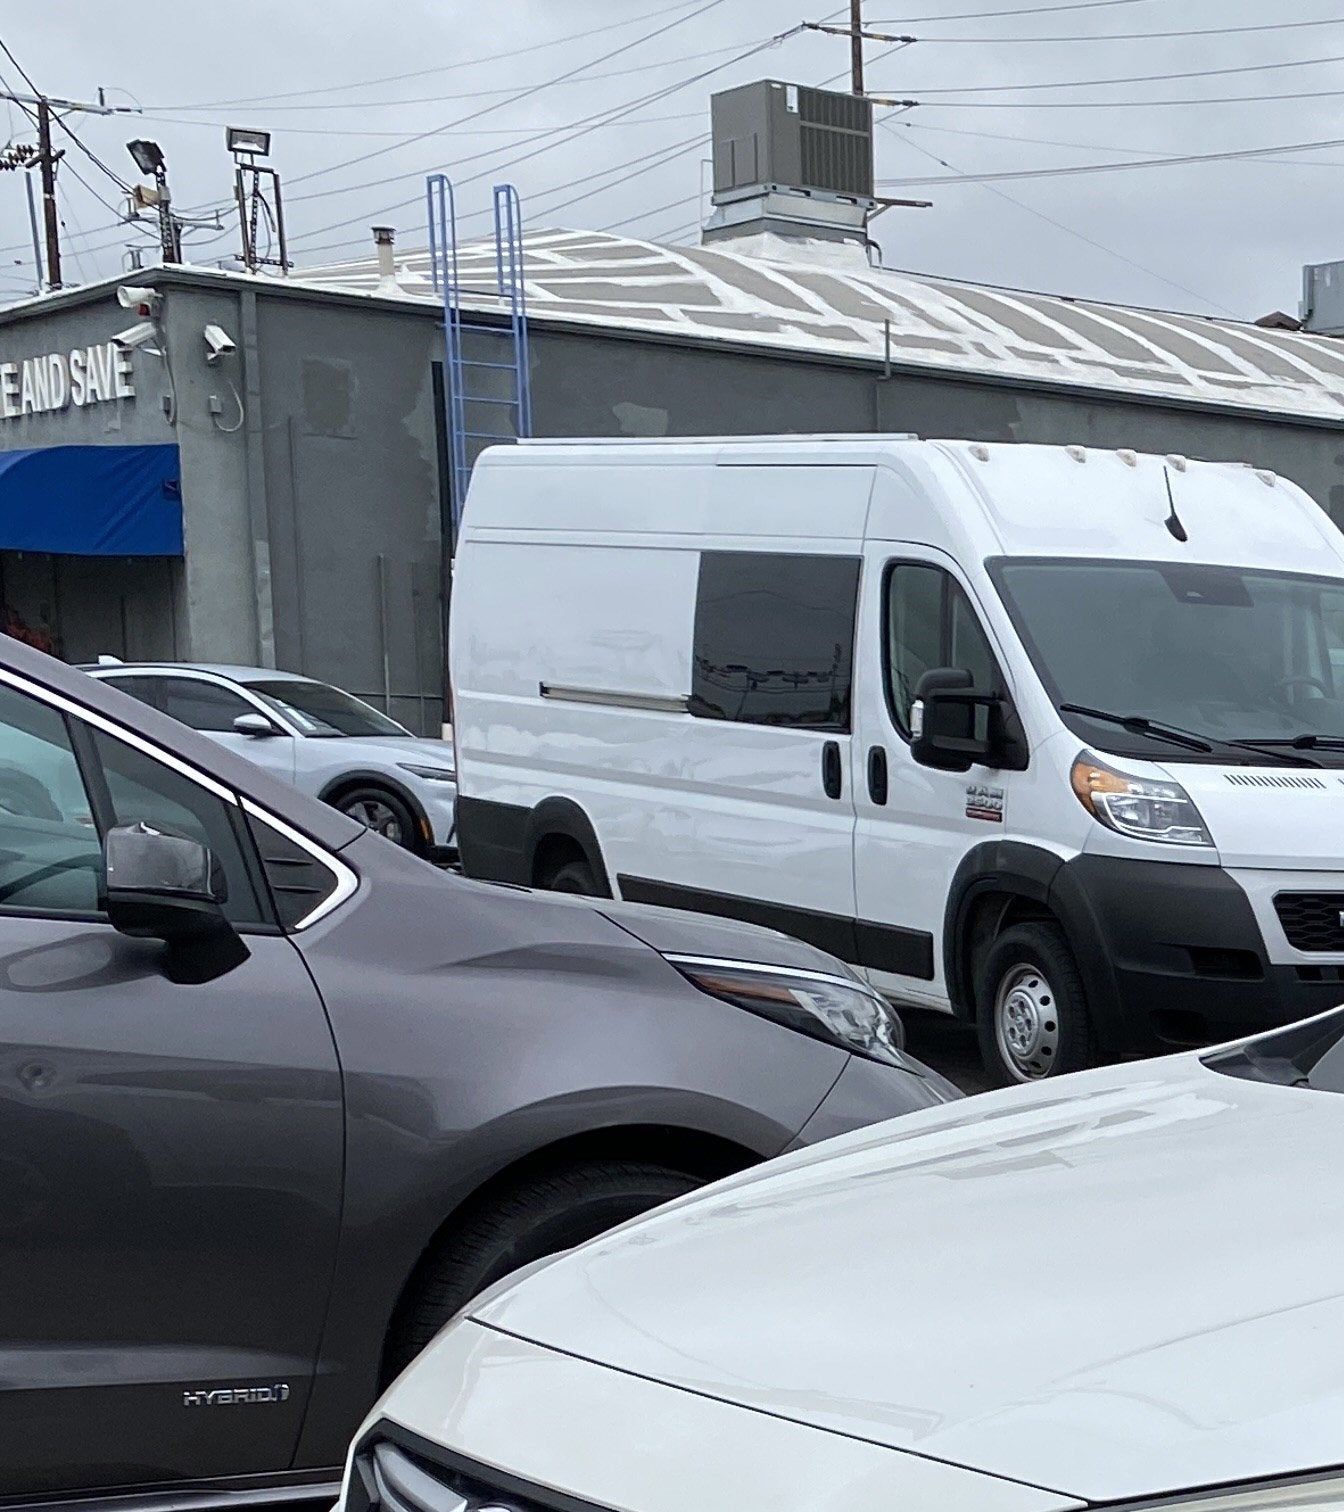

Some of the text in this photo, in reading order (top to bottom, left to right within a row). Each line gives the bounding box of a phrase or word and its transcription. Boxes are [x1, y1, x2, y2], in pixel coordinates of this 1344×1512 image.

[22, 353, 70, 415] AND
[70, 341, 136, 407] SAVE
[183, 1387, 273, 1406] HYBRID
